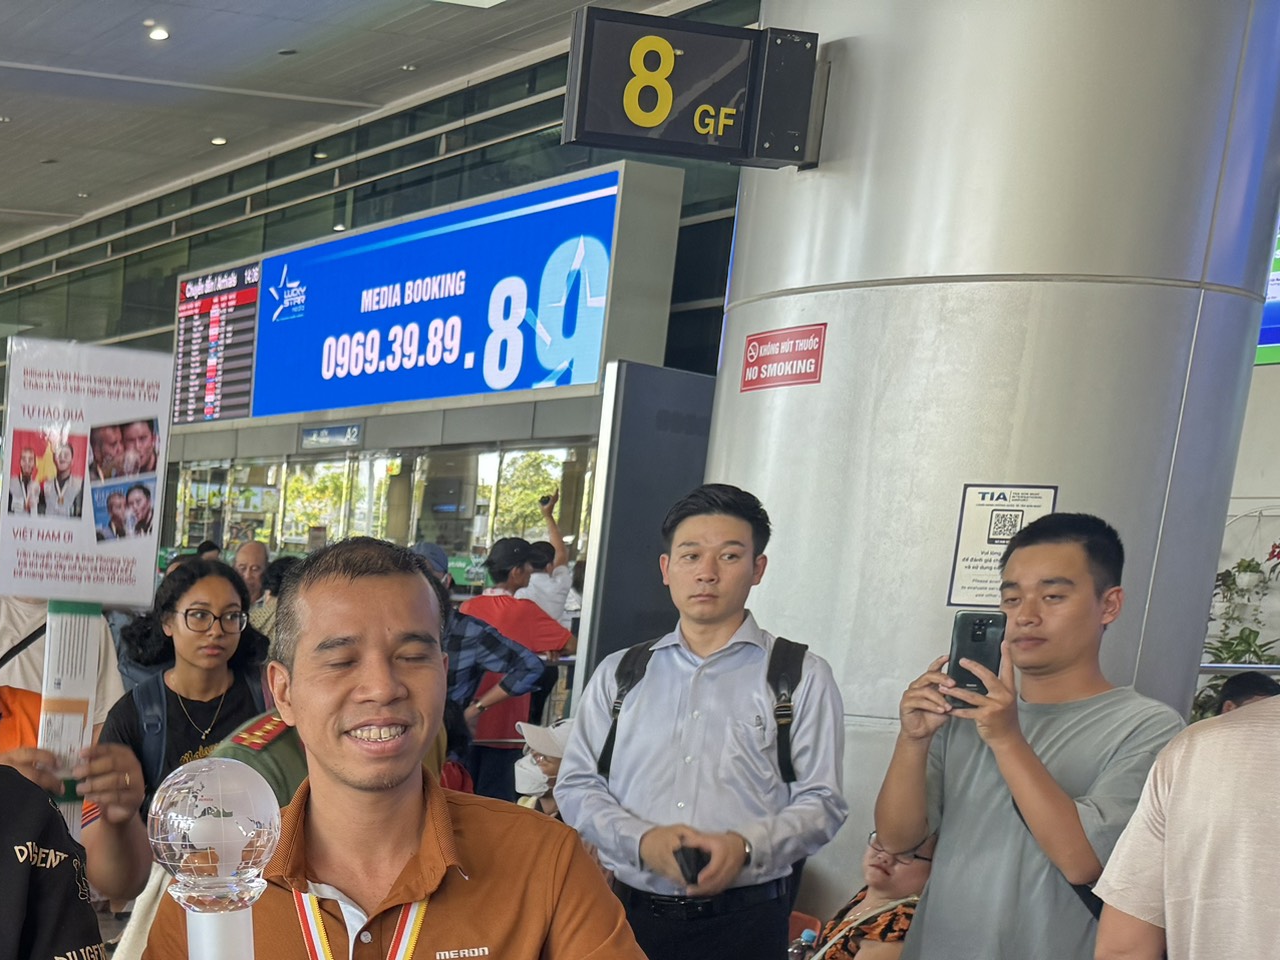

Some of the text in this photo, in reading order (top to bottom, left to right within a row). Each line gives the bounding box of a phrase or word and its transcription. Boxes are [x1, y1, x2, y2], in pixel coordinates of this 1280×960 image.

[623, 35, 737, 136] 8 GF
[360, 270, 466, 313] MEDIA BOOKING
[283, 295, 306, 308] STAR
[759, 333, 819, 357] KHÔNG HÚT THUỐC
[745, 358, 816, 381] NO SMOKING
[978, 492, 1008, 502] TIA
[12, 527, 33, 540] VIỆT
[37, 529, 60, 541] NAM
[435, 946, 489, 960] MERON
